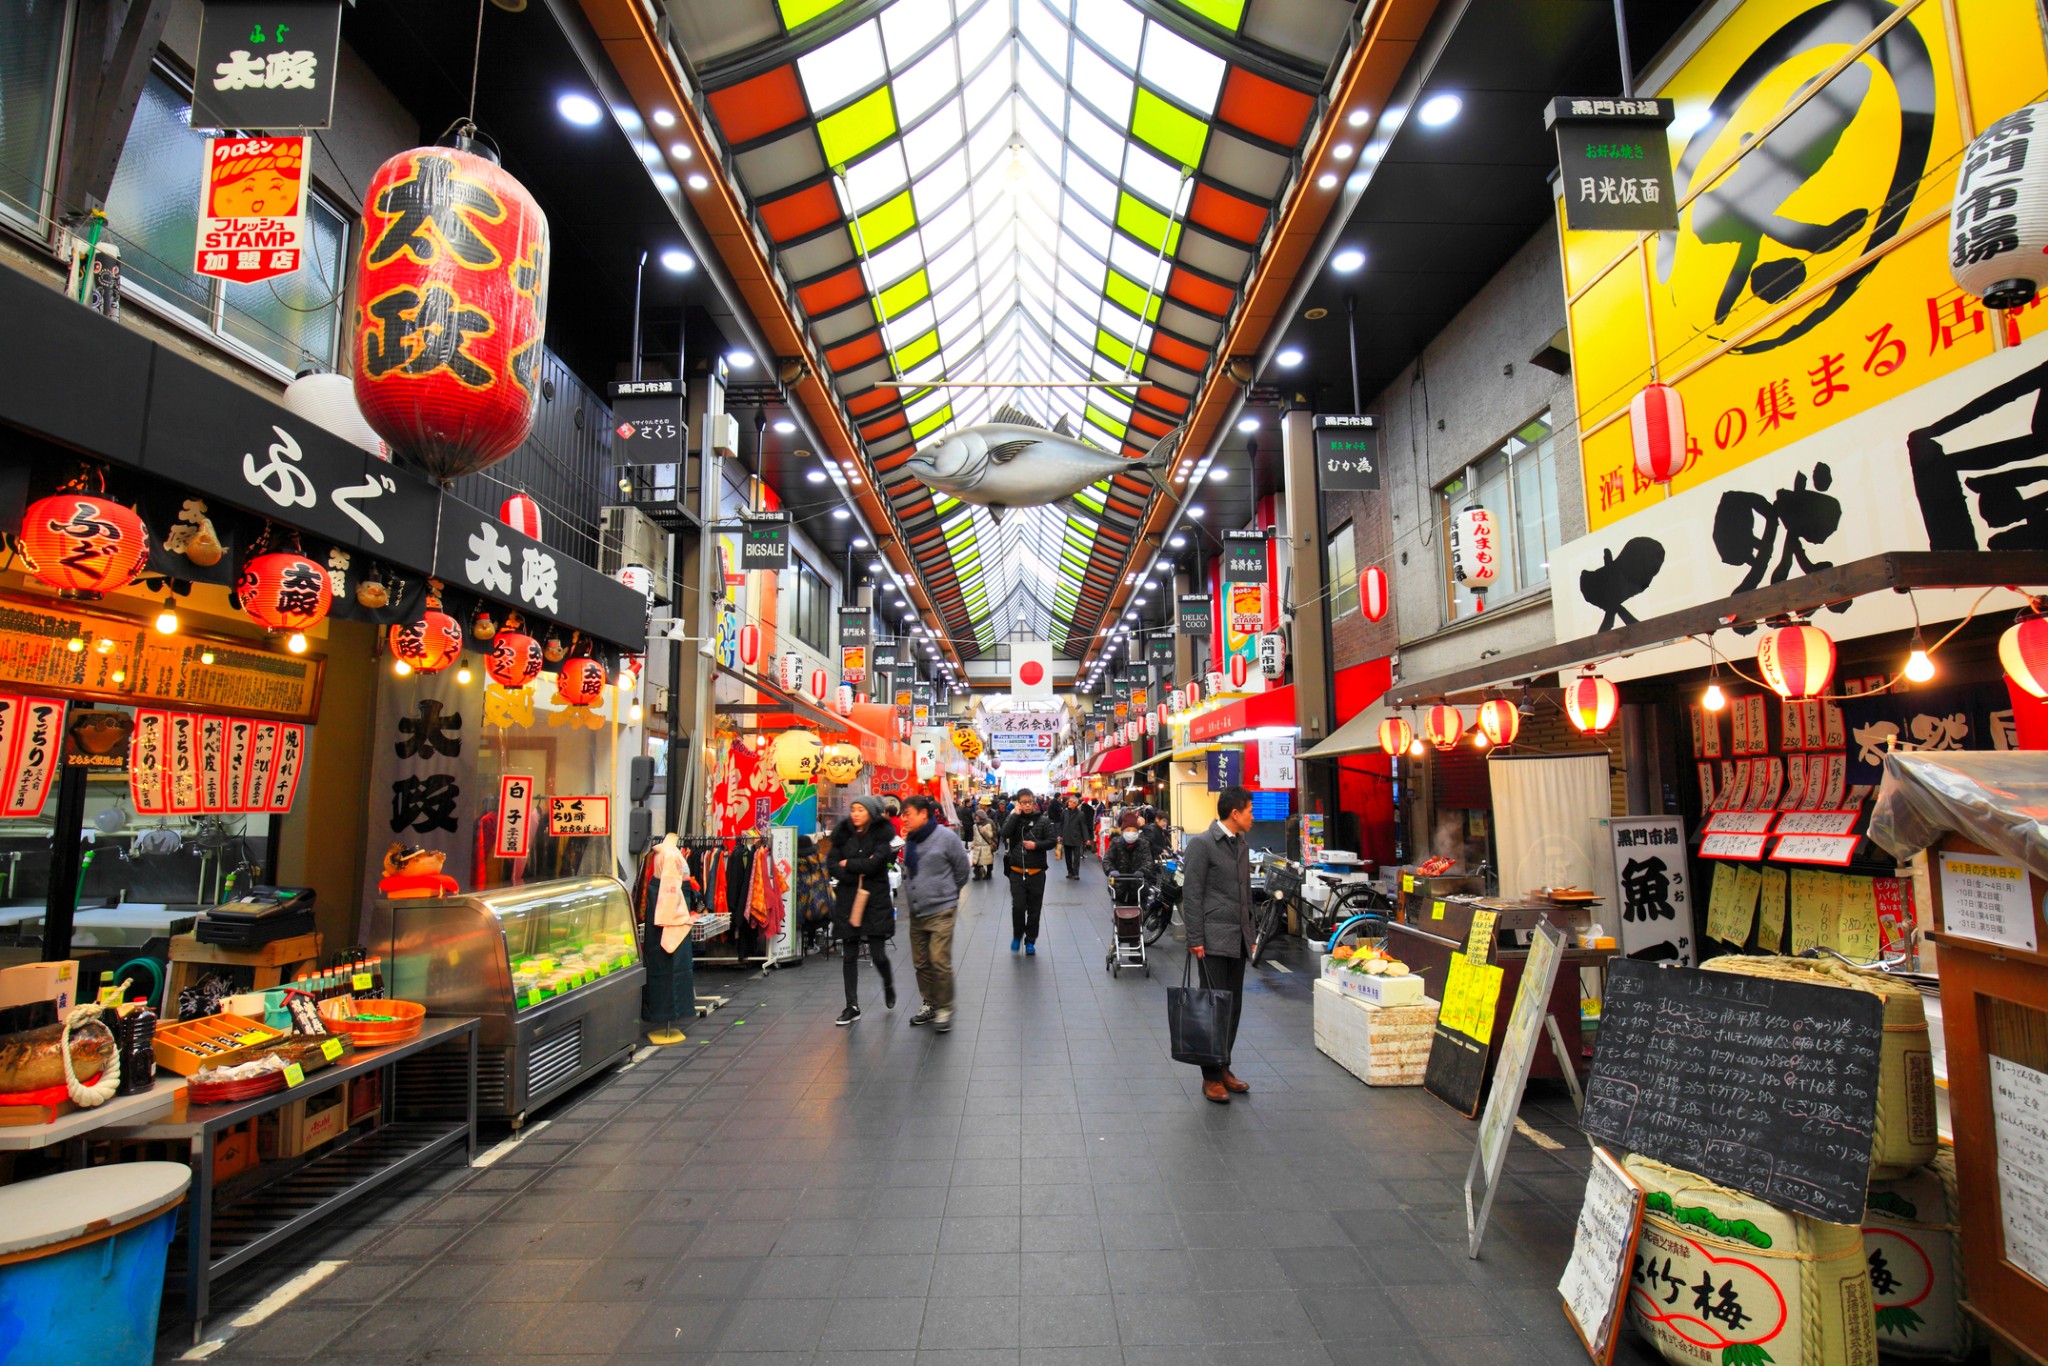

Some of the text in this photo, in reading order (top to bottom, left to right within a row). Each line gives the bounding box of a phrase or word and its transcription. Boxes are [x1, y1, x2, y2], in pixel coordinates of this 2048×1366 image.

[250, 24, 289, 43] ふぐ
[213, 50, 317, 90] 太政
[1571, 100, 1659, 115] 黒門市場
[216, 140, 274, 161] クロモン
[1586, 144, 1644, 159] お好み焼き
[1579, 176, 1660, 204] 月光仮面
[1953, 107, 2035, 269] 黒門市場
[205, 231, 295, 248] STAMP
[214, 218, 286, 232] フレッシュ
[203, 251, 295, 271] 加盟店
[366, 156, 508, 392] 太政
[641, 425, 676, 439] さくら
[243, 425, 396, 544] ふぐ
[465, 522, 558, 614] 太政
[48, 501, 121, 580] ふぐ
[746, 543, 785, 557] BIGSALE
[1471, 511, 1493, 579] ほんまもん
[1261, 637, 1276, 674] 黒門市場
[1787, 704, 1797, 732] し巻き
[29, 706, 53, 767] てっちり
[175, 719, 189, 771] てっちり
[232, 724, 247, 772] てっさ
[281, 730, 299, 776] 焼ひれ
[390, 700, 462, 833] 太政
[1279, 742, 1294, 780] 豆乳
[274, 780, 288, 806] 千円
[507, 782, 524, 825] 白子
[552, 799, 585, 812] ふぐ
[1617, 827, 1678, 847] 黒門市場
[1876, 881, 1903, 890] ヒゲの
[1621, 855, 1680, 961] 魚一
[1673, 873, 1691, 966] うお かず
[1765, 1015, 1790, 1029] 450
